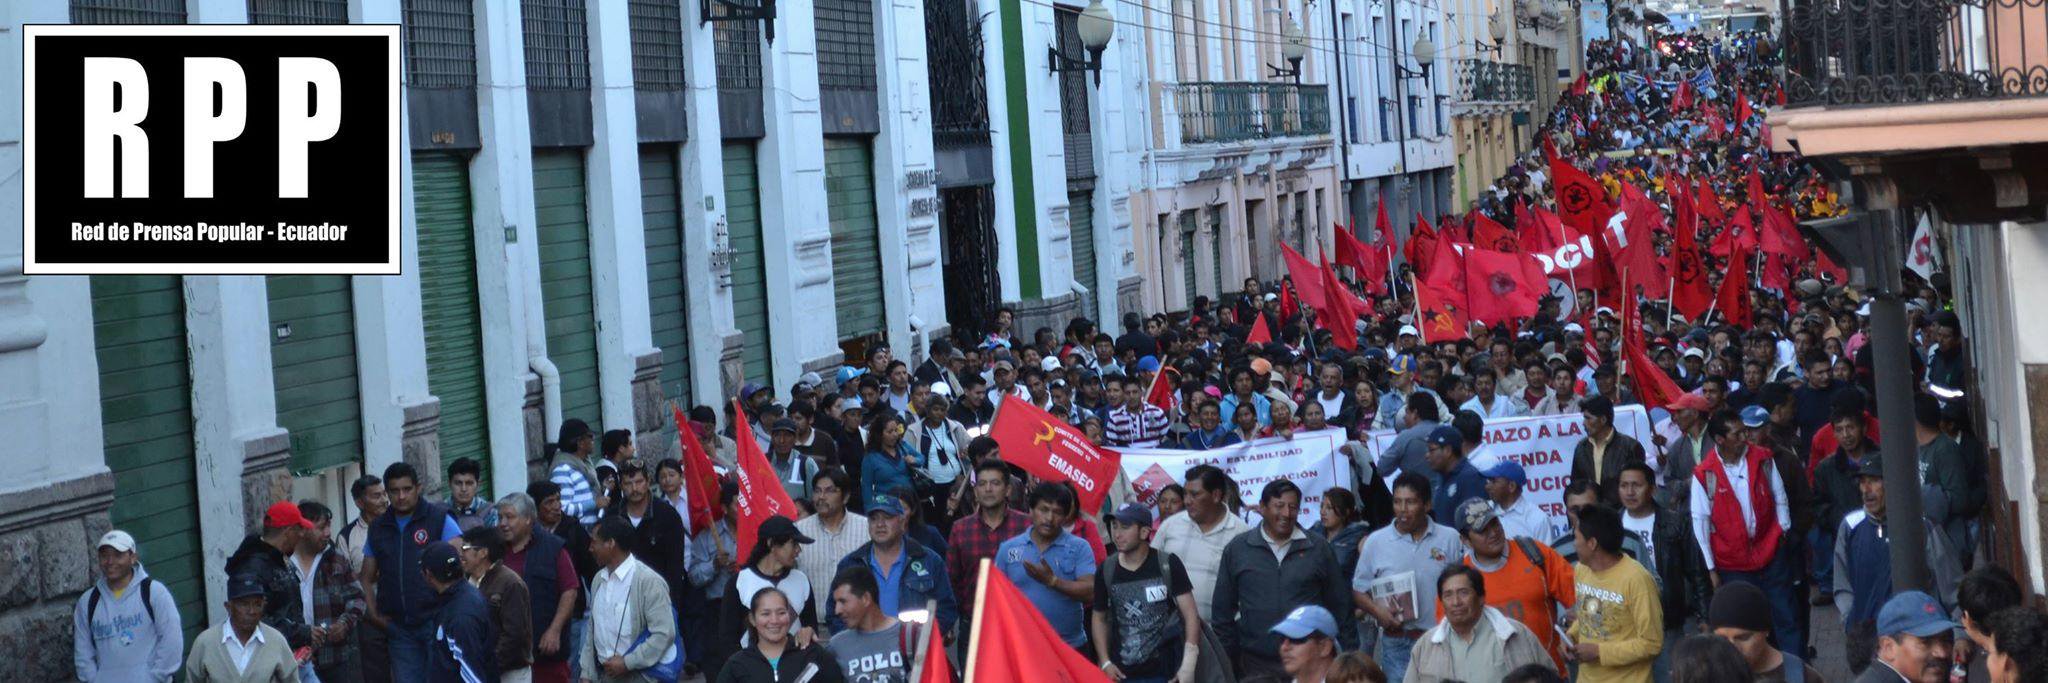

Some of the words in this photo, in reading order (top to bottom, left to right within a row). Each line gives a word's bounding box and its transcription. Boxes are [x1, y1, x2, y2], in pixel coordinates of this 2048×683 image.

[1538, 424, 1552, 439] A
[1557, 421, 1582, 437] LA
[1226, 447, 1303, 464] ESTABILIDAD
[1048, 453, 1095, 492] EMASEO
[848, 651, 903, 676] POLO
